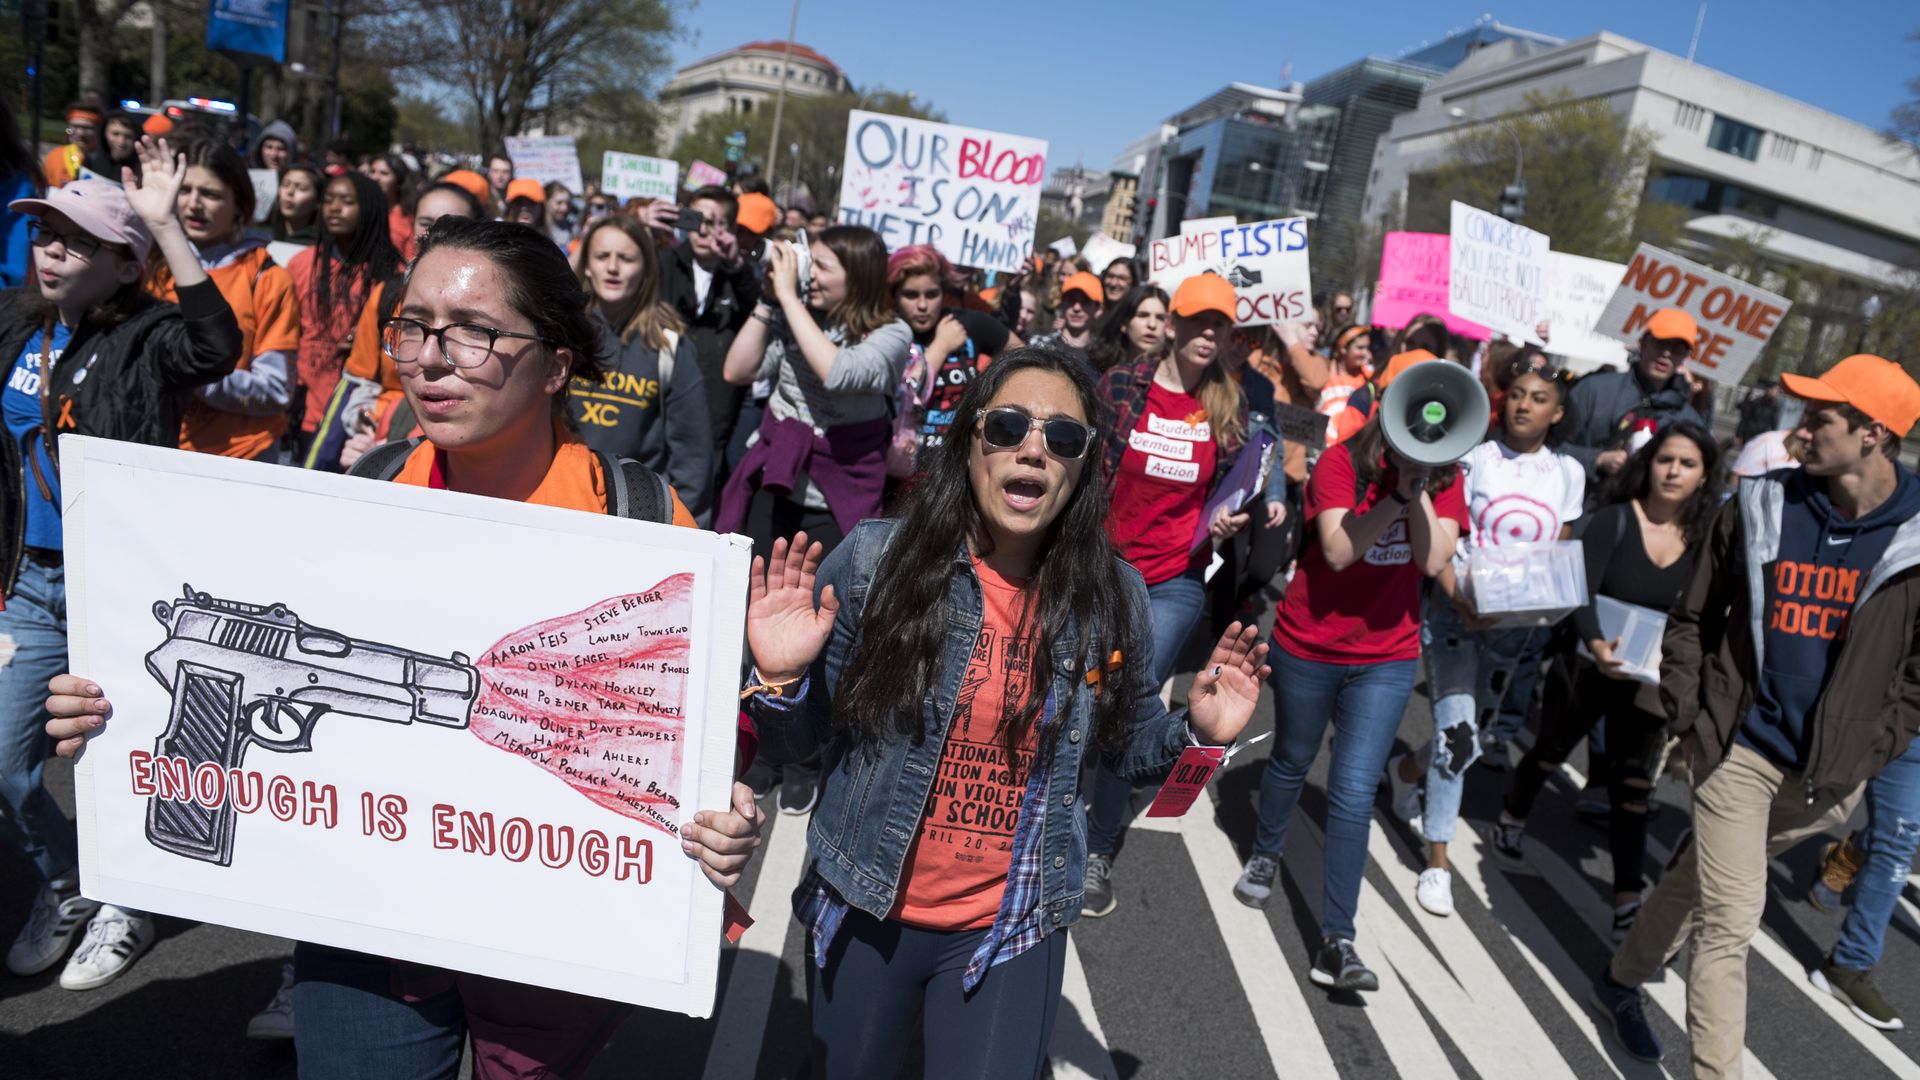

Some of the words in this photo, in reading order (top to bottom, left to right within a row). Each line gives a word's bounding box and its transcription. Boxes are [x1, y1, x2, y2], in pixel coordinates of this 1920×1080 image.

[856, 119, 950, 174] OUR
[958, 137, 1045, 186] BLOOD
[898, 176, 950, 216] IS
[954, 185, 1019, 223] ON
[1153, 231, 1218, 272] BUMP
[1221, 220, 1308, 258] FISTS
[1465, 211, 1532, 257] CONGRESS
[1455, 239, 1484, 273] YOU
[1487, 251, 1511, 282] ARE
[1516, 261, 1542, 295] NOT
[1235, 292, 1305, 323] OCKS
[1621, 253, 1708, 307] NOT
[1701, 285, 1783, 341] ONE
[1621, 303, 1734, 369] MRE
[581, 401, 620, 427] XC
[1153, 421, 1208, 437] Students
[1133, 436, 1187, 455] Demand
[1151, 462, 1194, 478] Action
[1369, 547, 1410, 561] Action
[584, 606, 620, 631] STEVE
[621, 591, 663, 612] BERGER
[491, 641, 535, 667] AARON
[539, 631, 568, 648] FEIS
[589, 633, 630, 645] LAUREN
[637, 625, 688, 636] TOWNSEND
[527, 660, 568, 671] OLIVIA
[574, 652, 609, 668] ENGEL
[619, 657, 654, 671] ISAIAH
[973, 648, 987, 661] ORE
[1004, 659, 1029, 673] MORE
[490, 681, 528, 699] NOAH
[538, 690, 589, 712] POZNER
[555, 675, 597, 691] DYLAN
[604, 681, 656, 697] HOCKLEY
[597, 698, 626, 711] TARA
[473, 701, 527, 724] JOAQUIN
[540, 717, 585, 740] OLIVER
[589, 720, 623, 736] DAVE
[628, 726, 677, 742] SANDERS
[494, 731, 551, 764] MEADOW
[559, 758, 607, 787] POLLACK
[534, 734, 590, 758] HANNAH
[602, 750, 649, 765] AHLERS
[611, 767, 641, 788] JACK
[646, 781, 681, 809] BEATON
[934, 778, 957, 798] UN
[988, 769, 1028, 788] AGAI
[129, 750, 338, 829] ENOUGH
[361, 791, 408, 842] IS
[432, 804, 654, 885] ENOUGH
[616, 790, 645, 812] HALEY
[646, 805, 679, 834] KREUGER
[921, 828, 953, 844] PRIL
